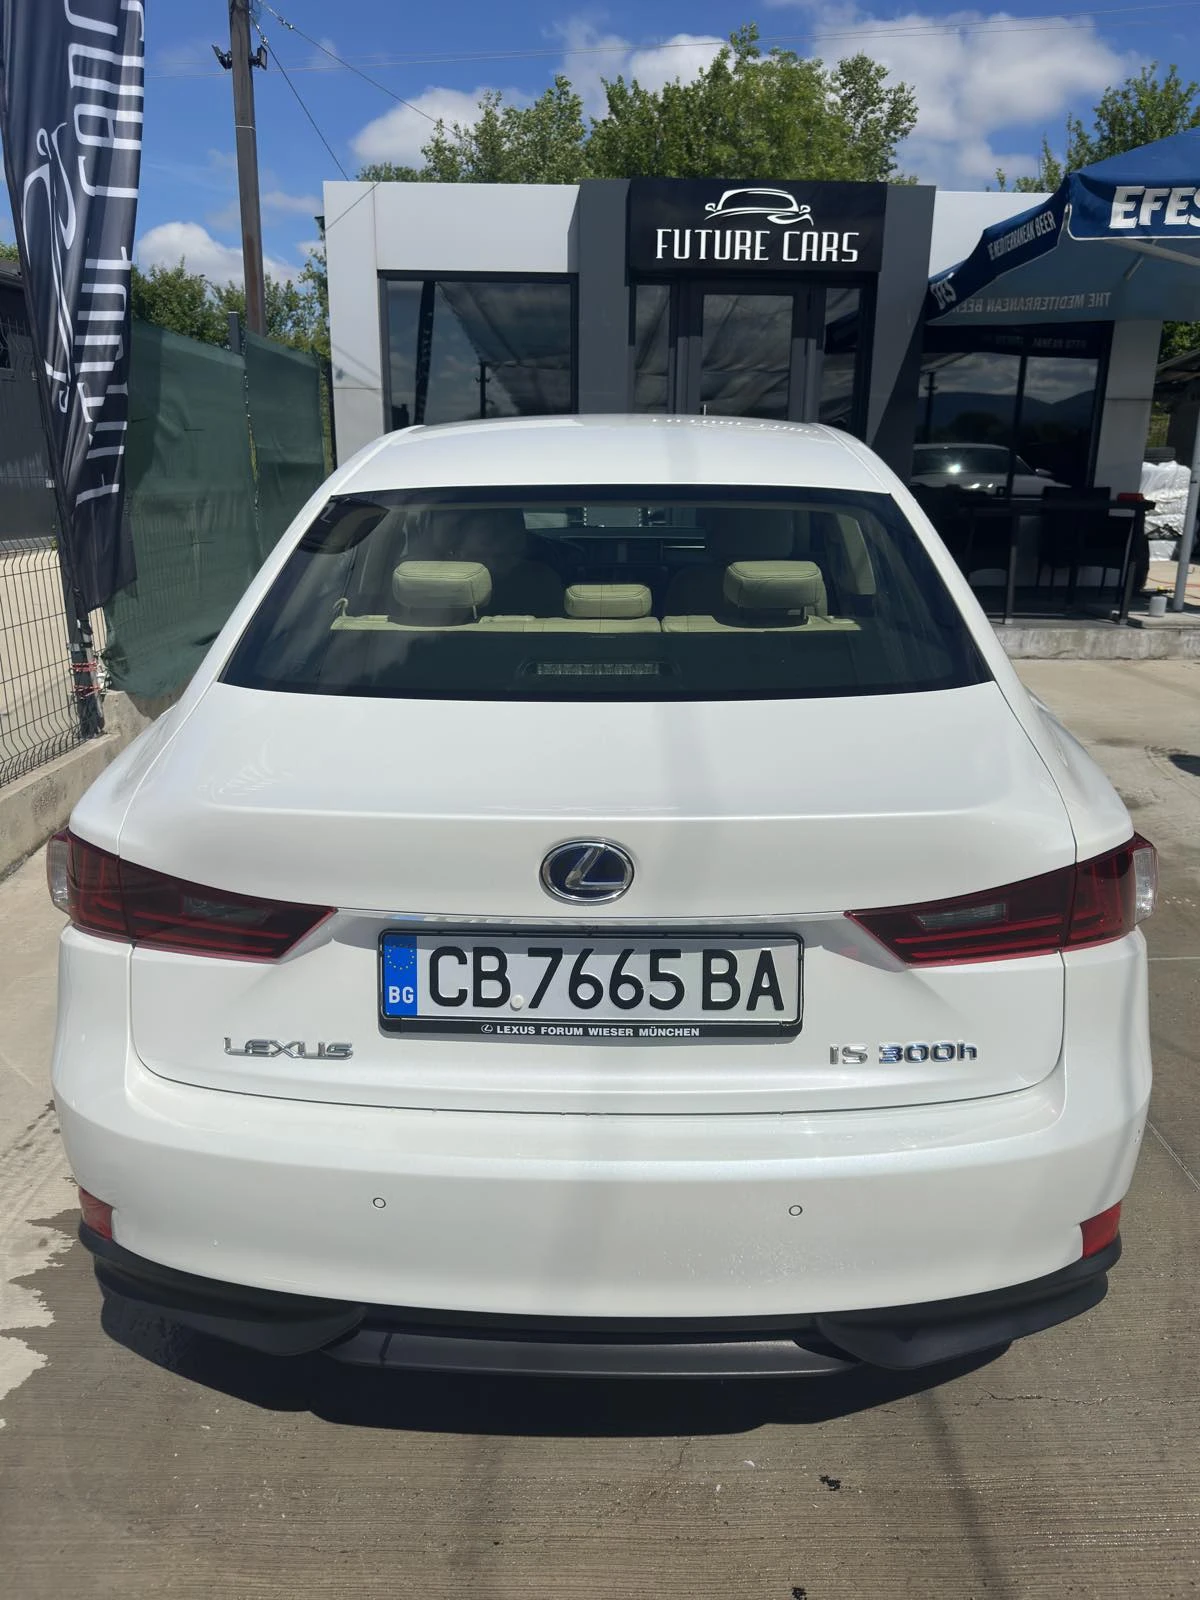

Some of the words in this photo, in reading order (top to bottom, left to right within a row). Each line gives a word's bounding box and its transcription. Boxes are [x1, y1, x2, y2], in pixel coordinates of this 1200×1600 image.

[1034, 210, 1057, 237] BEER
[655, 228, 770, 261] FUTURE
[782, 231, 859, 263] CARS
[429, 945, 511, 1008] CB
[527, 946, 685, 1011] 7665
[701, 948, 785, 1012] BA
[388, 985, 414, 1004] BG
[496, 1025, 536, 1035] LEXUS
[541, 1026, 583, 1036] FORUM
[588, 1027, 634, 1037] WIESER
[638, 1026, 700, 1037] MÜNCHEN
[223, 1036, 353, 1060] LEXUS
[829, 1043, 868, 1065] IS
[878, 1039, 978, 1065] 300h
